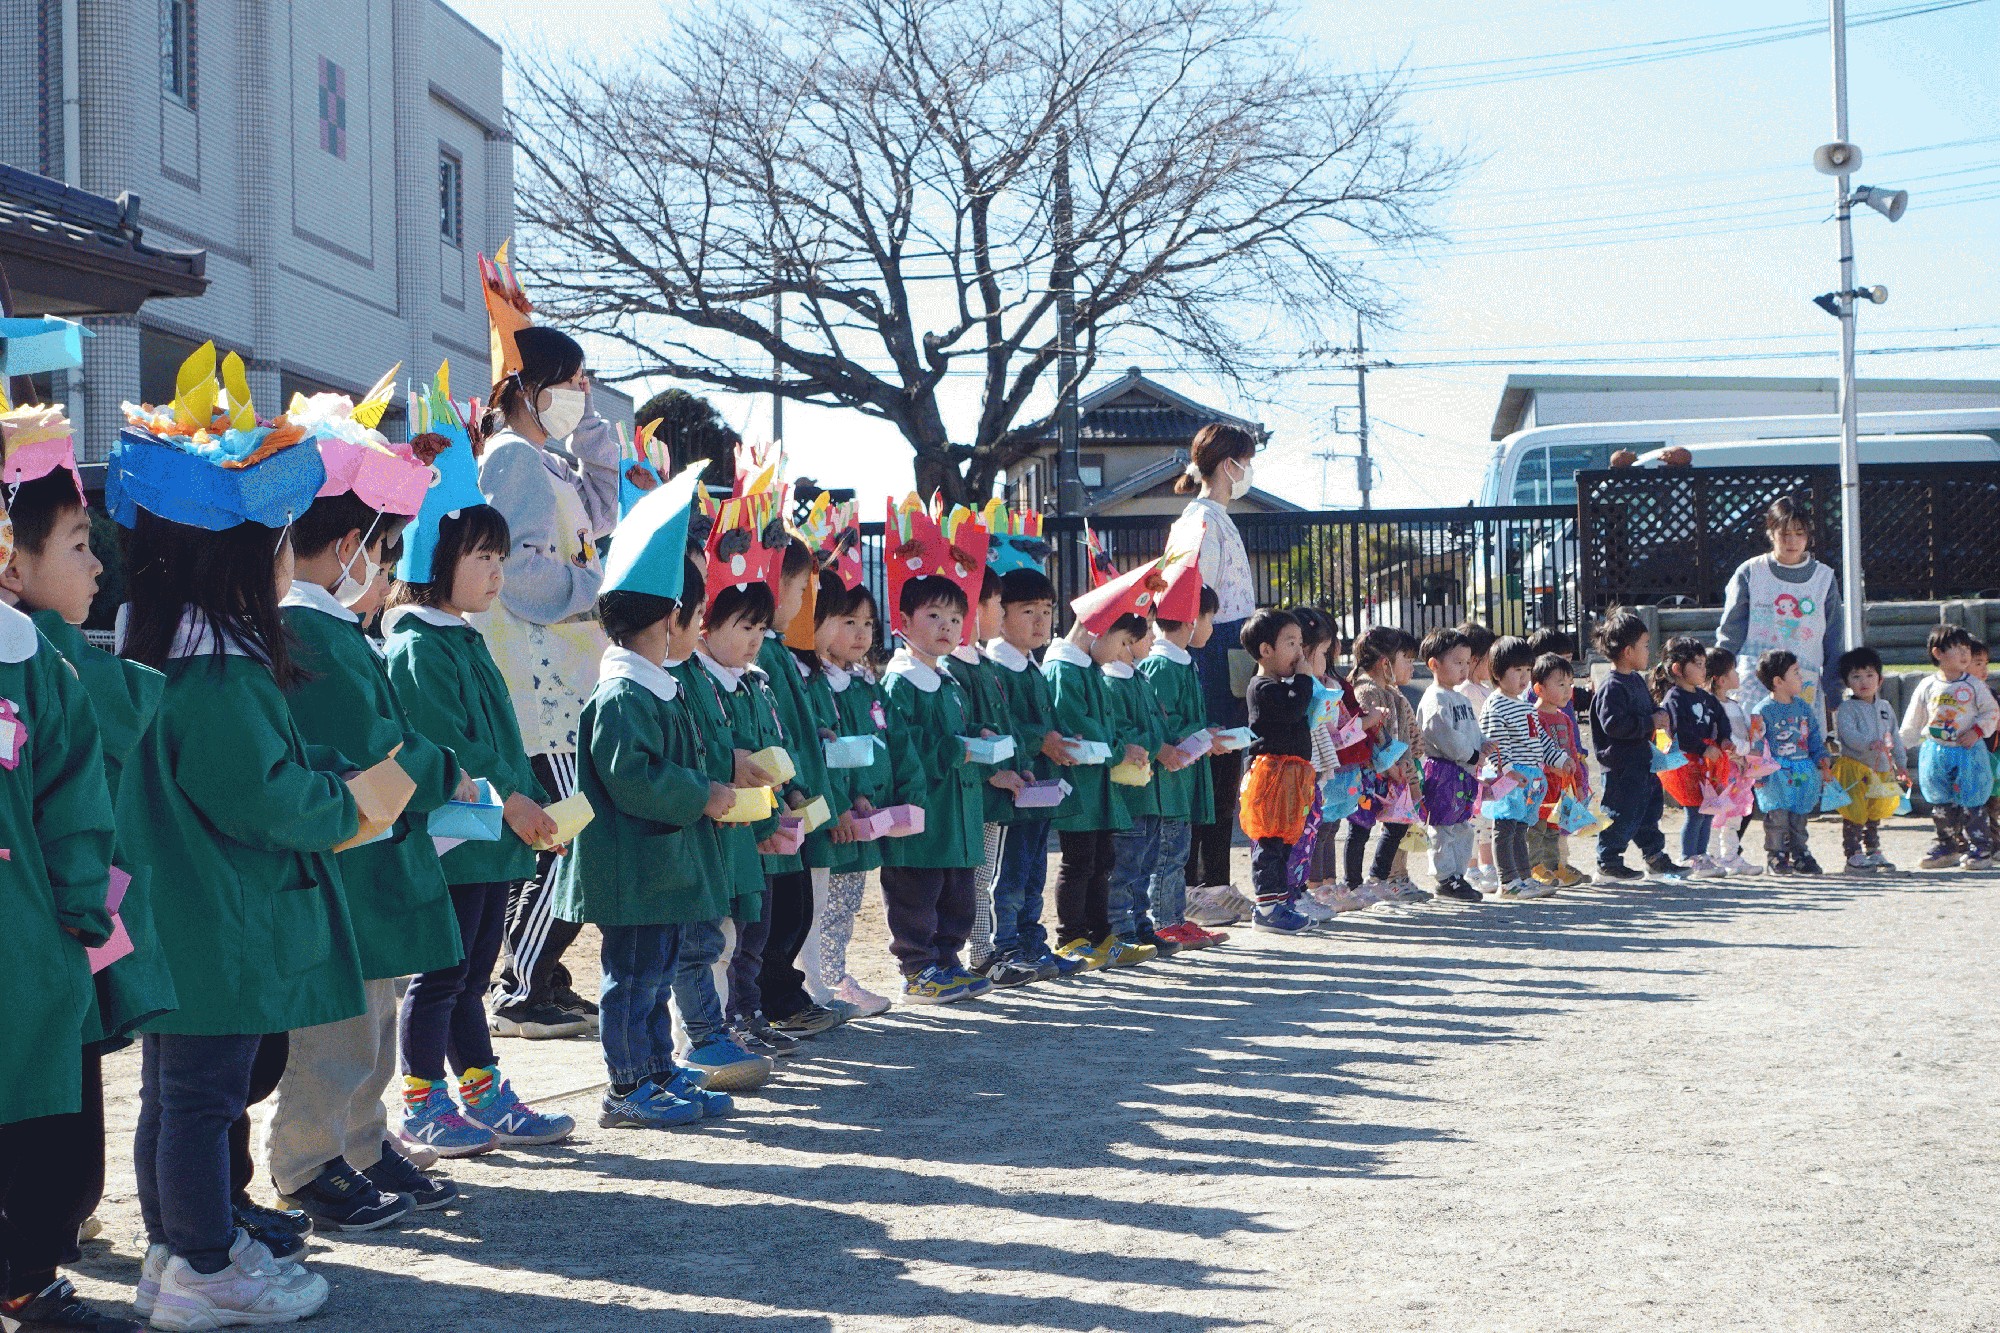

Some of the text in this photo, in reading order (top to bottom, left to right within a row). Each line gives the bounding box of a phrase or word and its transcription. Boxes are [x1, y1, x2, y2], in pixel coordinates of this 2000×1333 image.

[1107, 945, 1124, 959] N
[986, 964, 1007, 981] N
[416, 1121, 446, 1144] N
[493, 1112, 527, 1134] N
